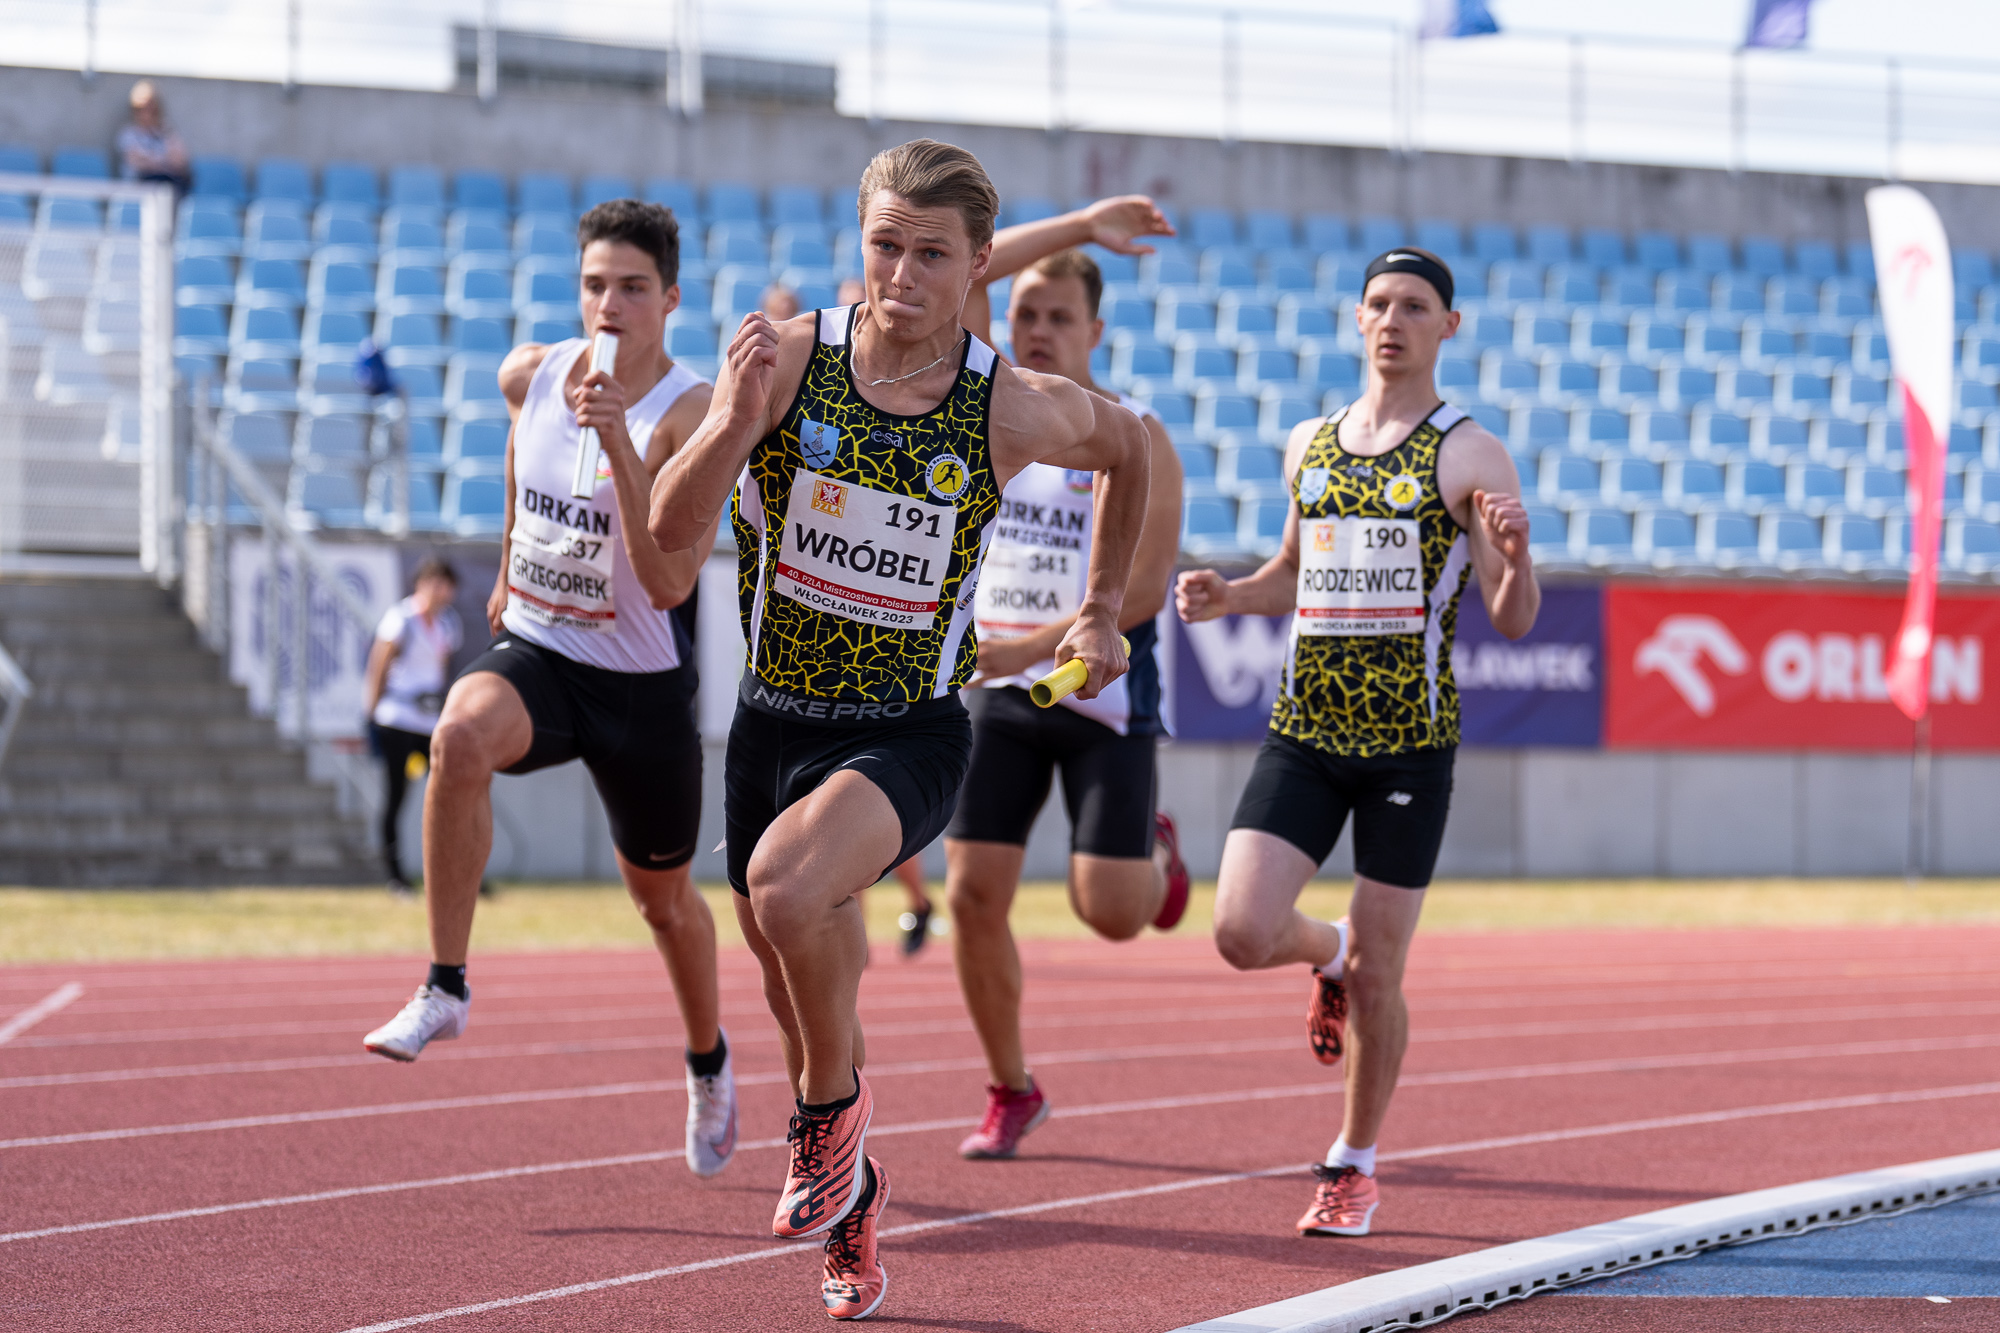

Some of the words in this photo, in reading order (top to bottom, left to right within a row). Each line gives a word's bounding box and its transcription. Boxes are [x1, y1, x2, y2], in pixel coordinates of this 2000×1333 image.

[525, 488, 610, 536] ORKAN
[813, 500, 841, 516] PZLA
[885, 502, 941, 538] 191
[795, 522, 935, 587] WRÓBEL
[1364, 527, 1407, 549] 190
[513, 554, 608, 601] GRZEGOREK
[1028, 553, 1067, 575] 341
[1304, 568, 1417, 592] RODZIEWICZ
[787, 569, 801, 581] 40.
[801, 574, 822, 589] PZLA
[823, 582, 880, 604] Mistrzostwa
[880, 598, 909, 611] Polski
[910, 603, 928, 612] U23
[793, 585, 880, 620] WŁOCŁAWEK
[881, 611, 914, 624] 2023
[989, 587, 1060, 612] SROKA
[1760, 629, 1984, 705] ORLN
[752, 685, 831, 719] NIKE
[831, 701, 910, 721] PRO
